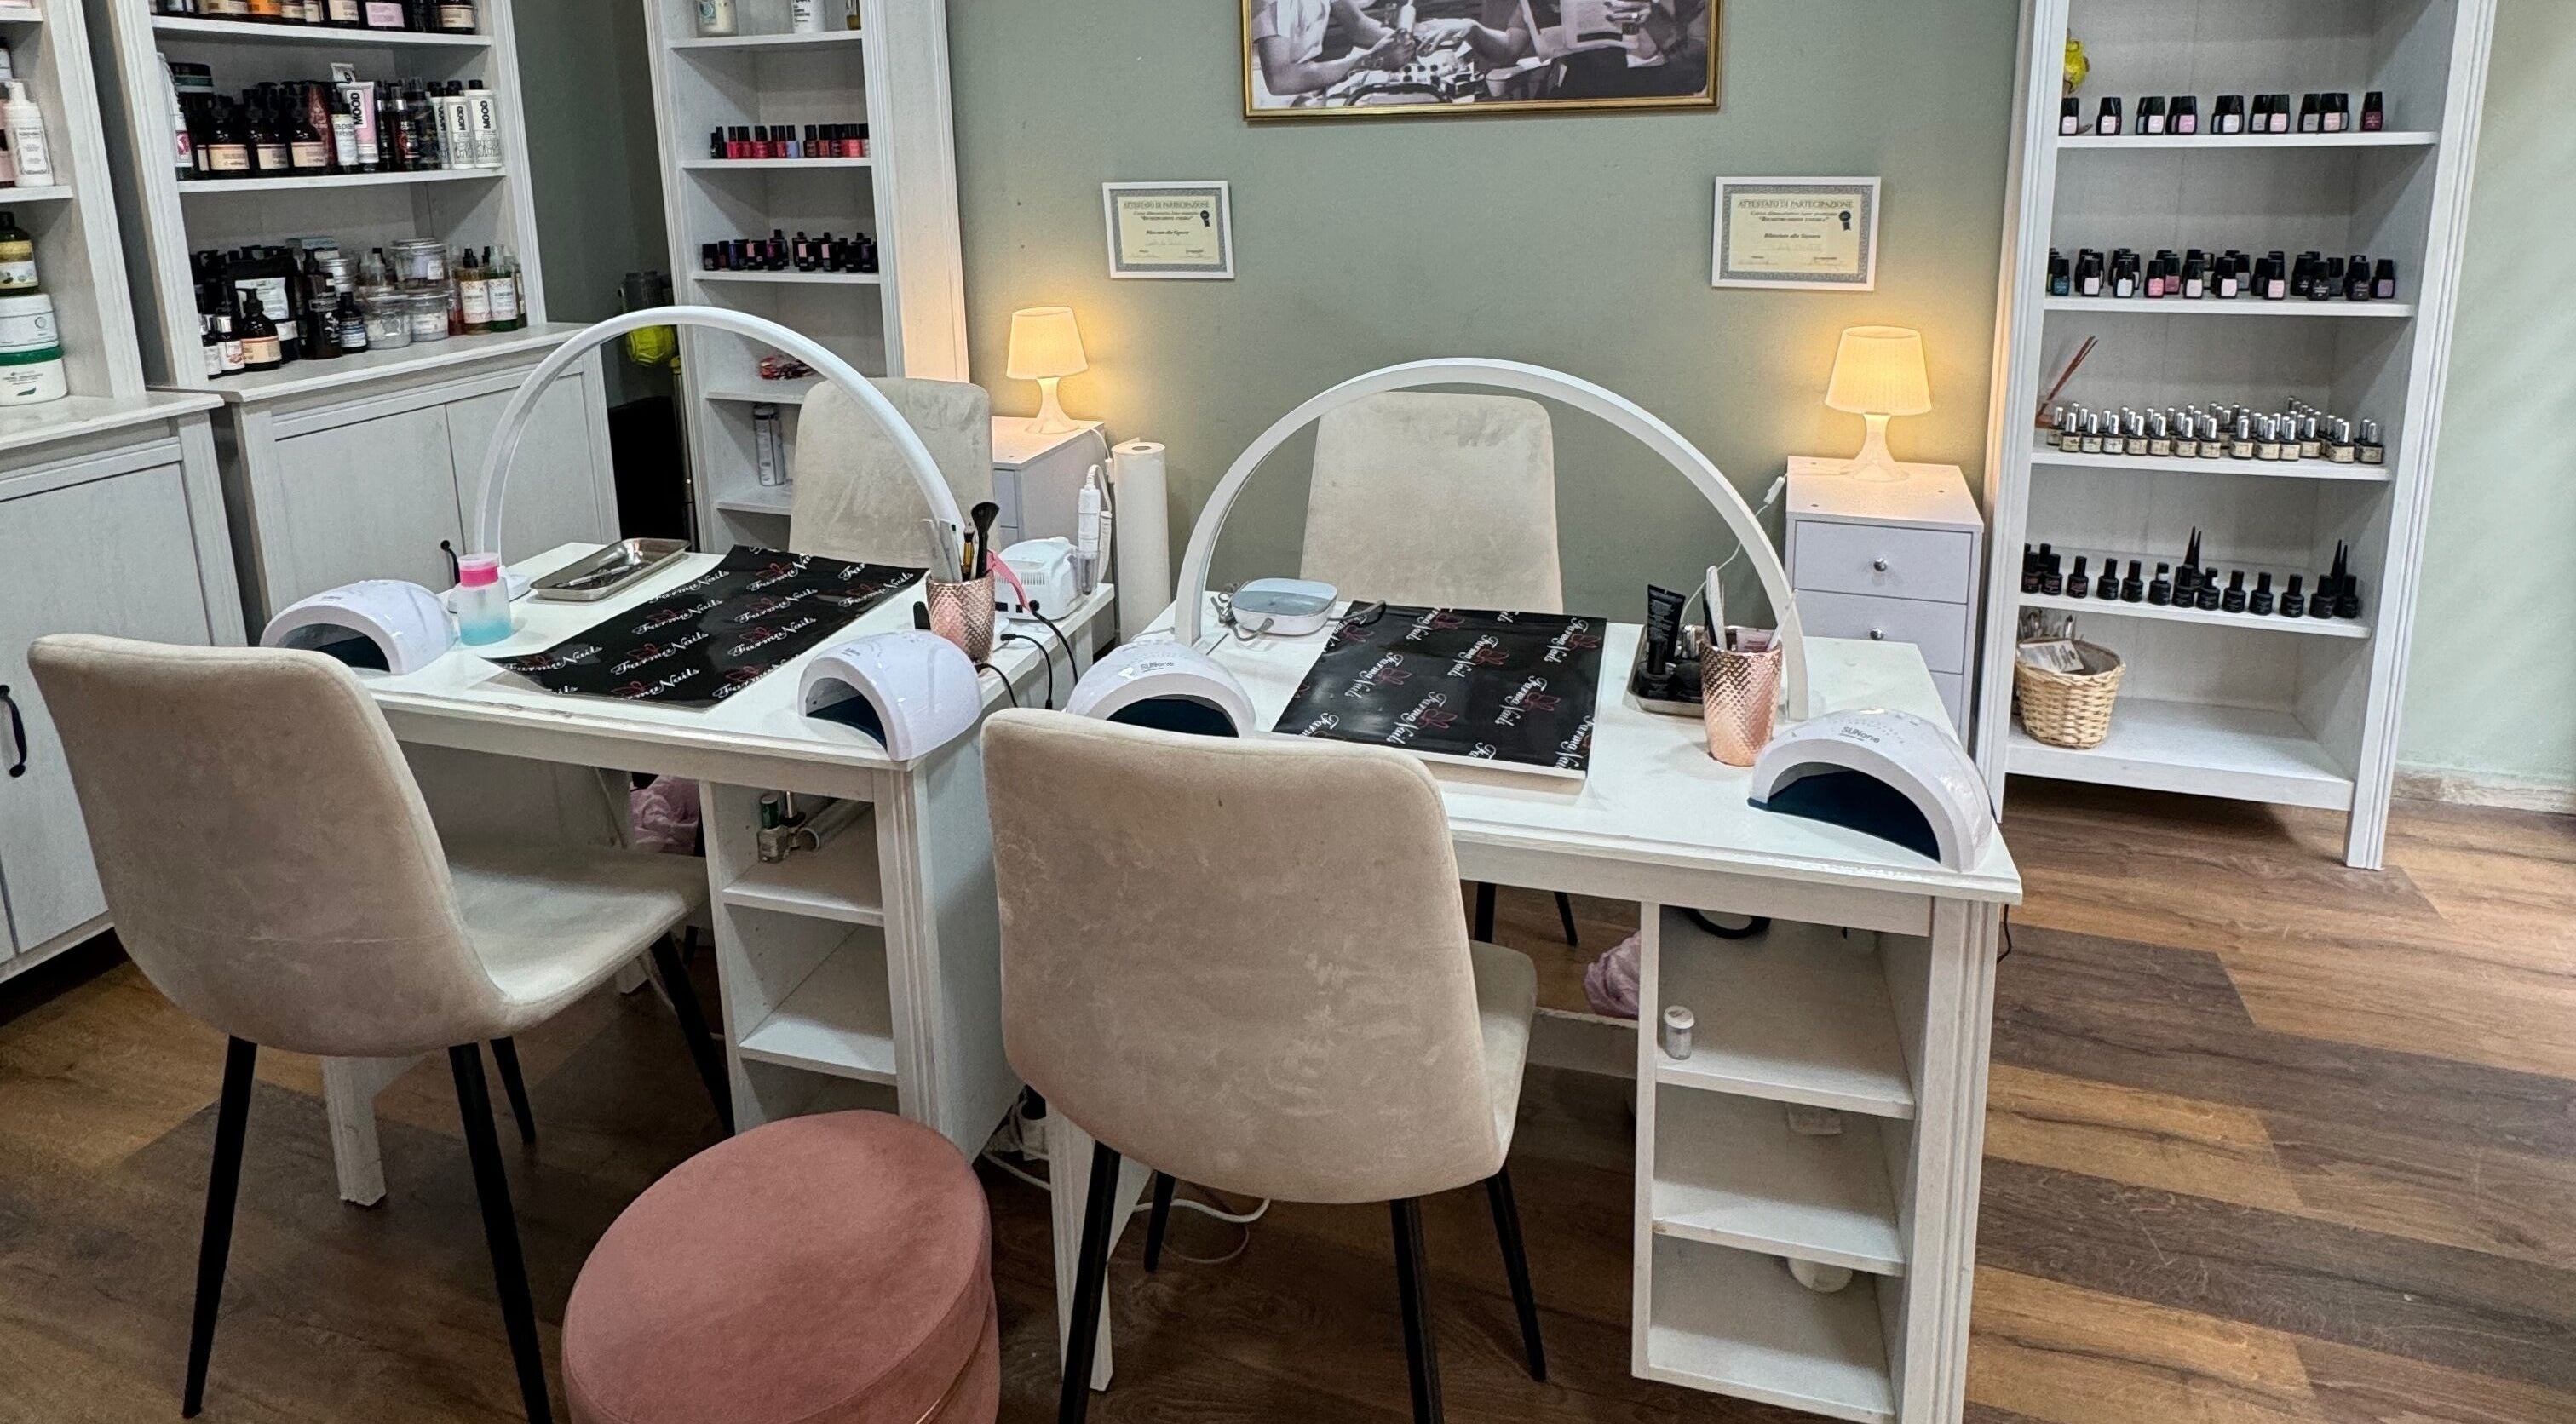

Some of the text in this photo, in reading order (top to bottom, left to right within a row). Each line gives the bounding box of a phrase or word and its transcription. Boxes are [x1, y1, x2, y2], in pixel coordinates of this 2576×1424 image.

[350, 92, 364, 125] MOOD
[456, 106, 467, 131] MOOD
[480, 100, 492, 129] MOOD
[1738, 199, 1854, 210] ATTESTATO DI PARTECIPAZIONE
[1841, 726, 1881, 744] SUNone
